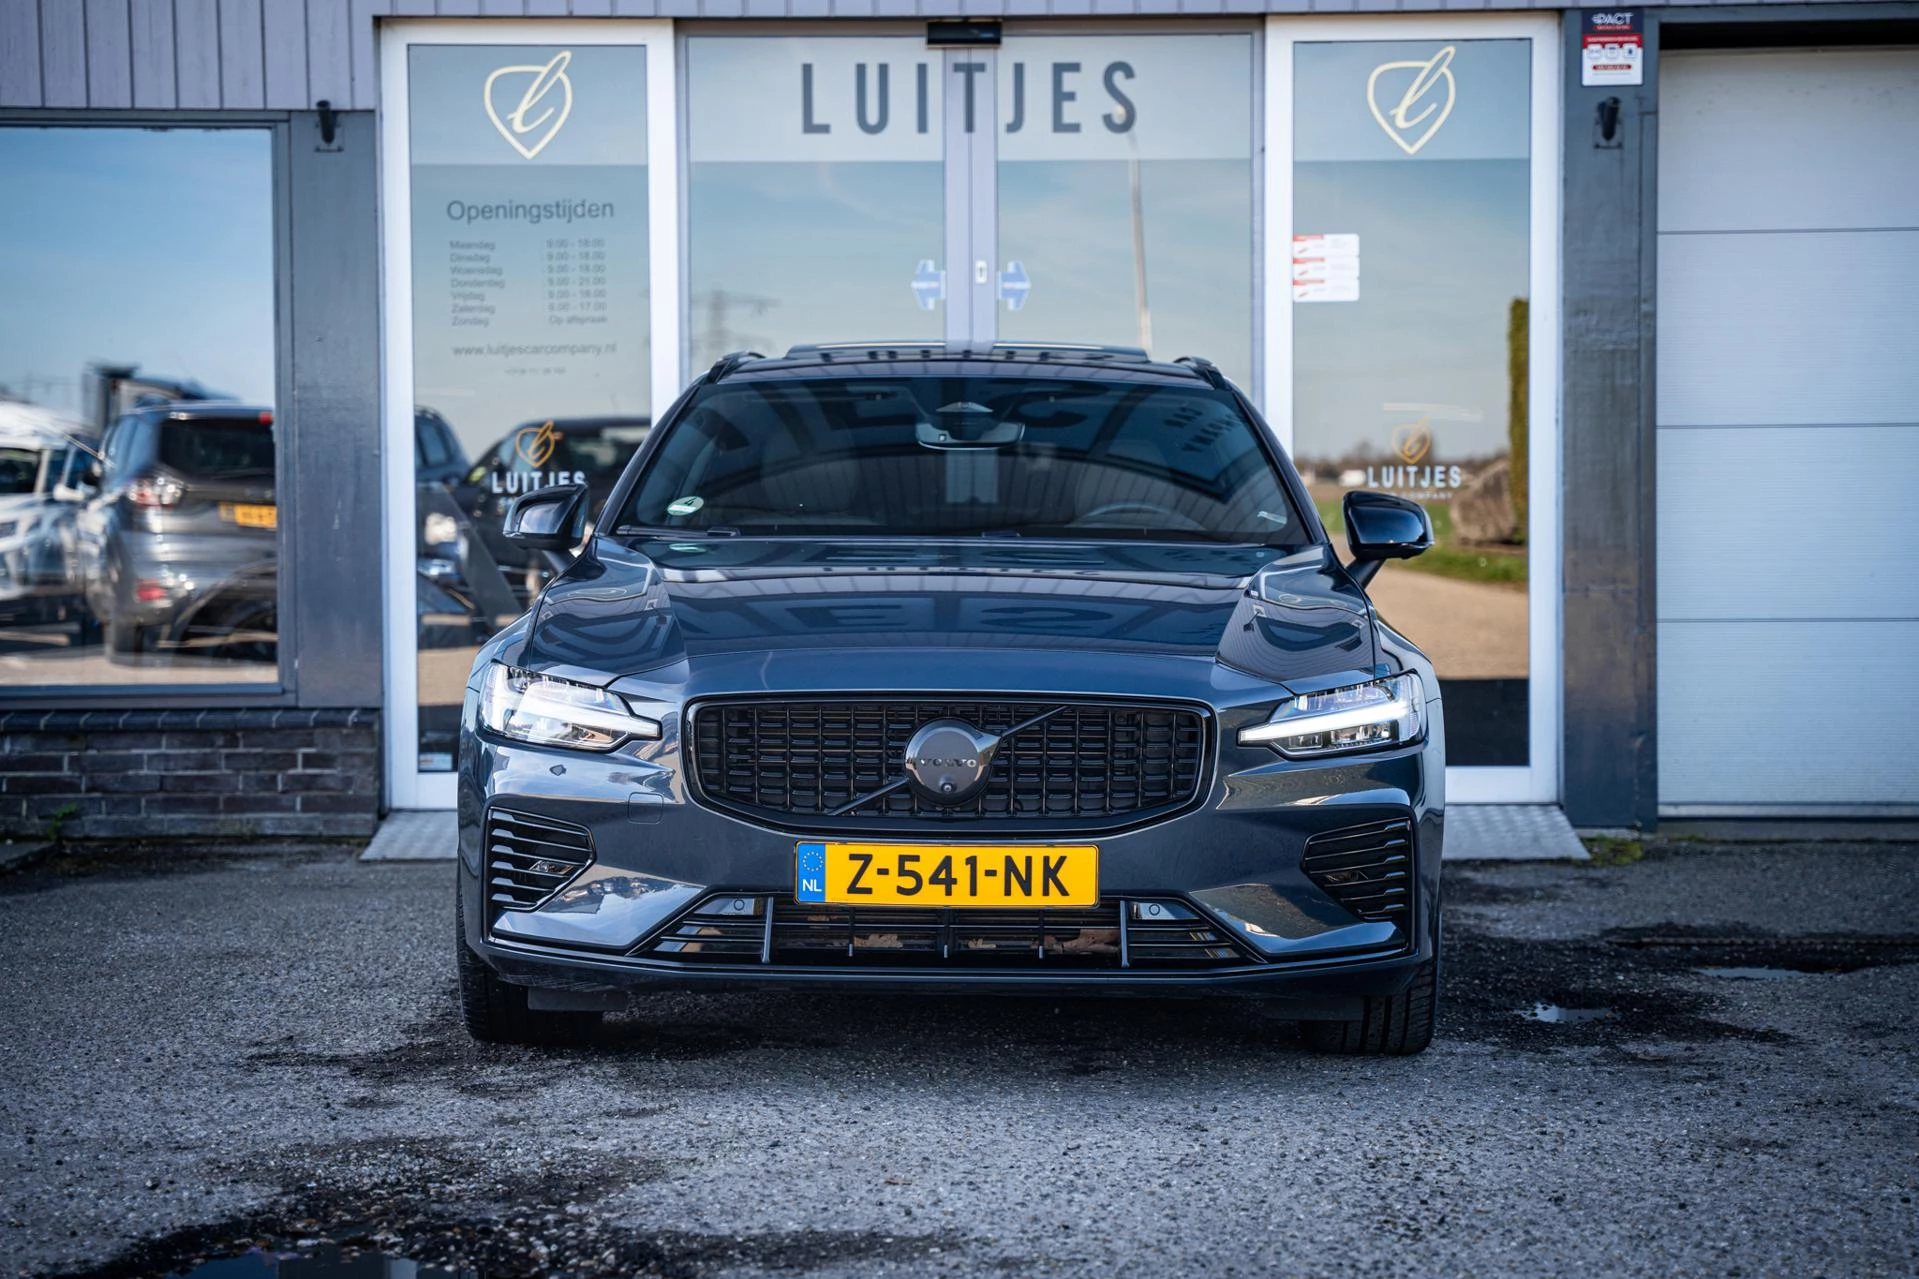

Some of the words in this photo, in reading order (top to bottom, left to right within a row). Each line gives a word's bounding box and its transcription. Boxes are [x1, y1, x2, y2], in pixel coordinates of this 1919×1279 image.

[801, 61, 1137, 134] LUITJES
[447, 200, 614, 225] Openingstijden
[1367, 465, 1462, 488] LUITJES
[920, 758, 977, 768] VOLVO
[802, 878, 822, 892] NL
[847, 853, 1070, 898] Z-541-NK
